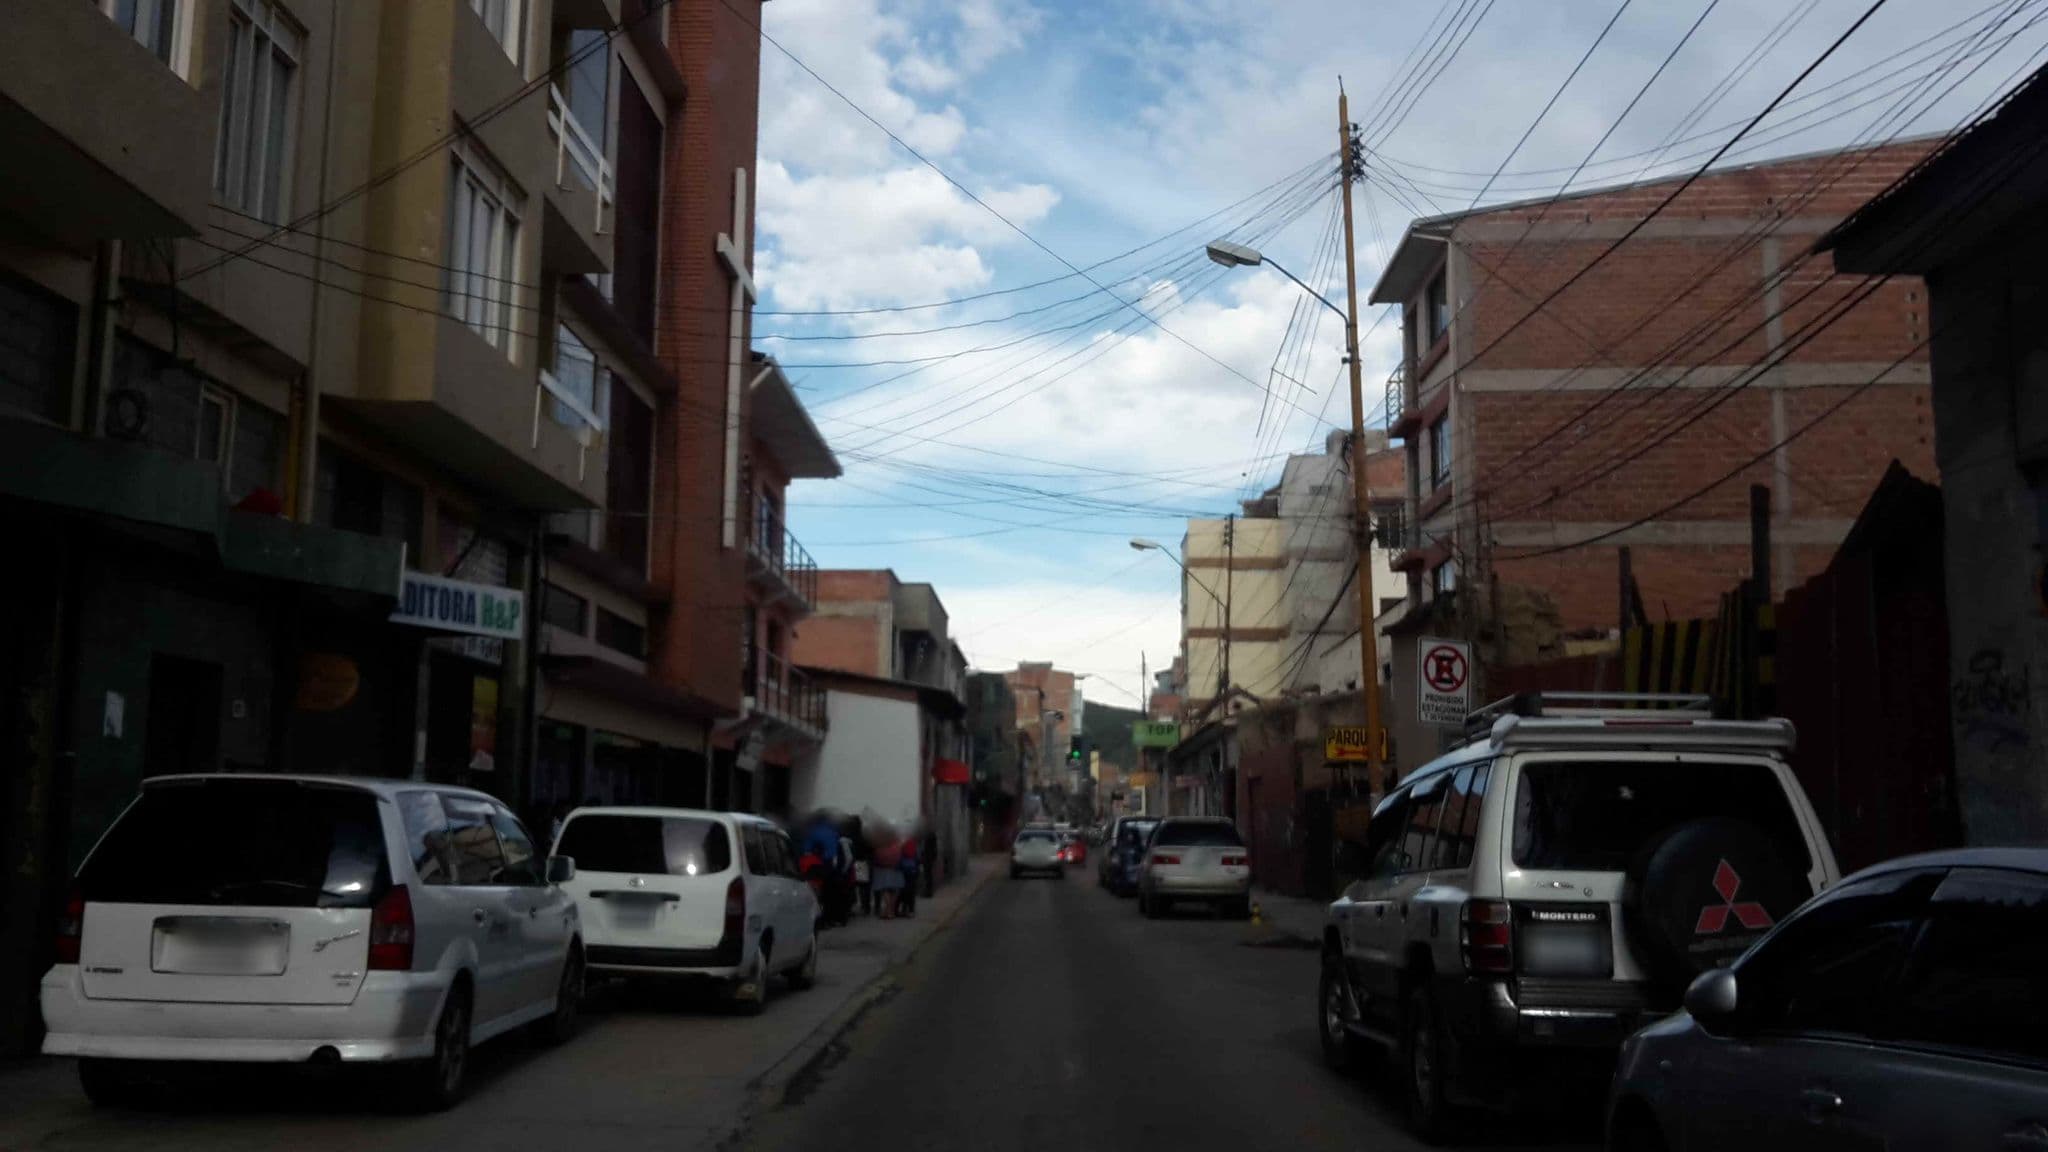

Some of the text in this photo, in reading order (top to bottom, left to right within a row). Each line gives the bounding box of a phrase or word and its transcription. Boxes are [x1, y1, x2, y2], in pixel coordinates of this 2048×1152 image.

[399, 580, 520, 631] DITORA H&P
[1425, 693, 1464, 704] PROHIBIDO
[1422, 703, 1465, 713] ESTACIONAR
[1147, 724, 1175, 736] TOP
[1328, 728, 1384, 746] PARQU
[1539, 911, 1596, 921] MONTERO
